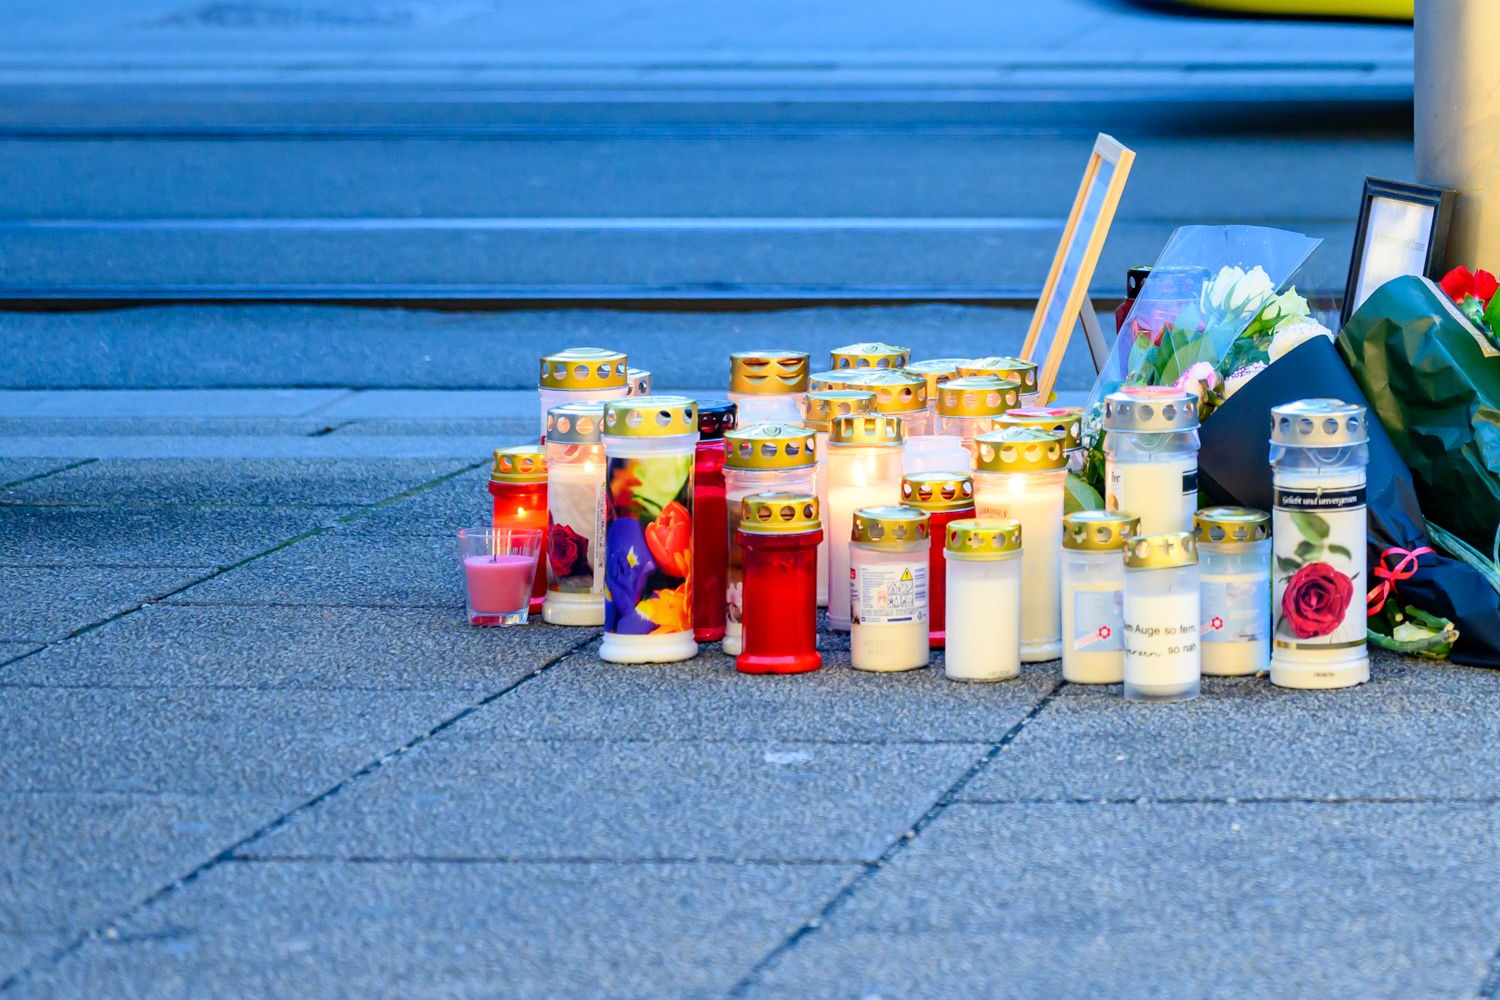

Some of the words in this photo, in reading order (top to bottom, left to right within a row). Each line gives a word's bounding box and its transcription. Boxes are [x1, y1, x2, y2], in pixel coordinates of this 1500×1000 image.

[1303, 496, 1318, 506] und
[1135, 624, 1160, 637] Auge
[1164, 627, 1176, 636] so
[1168, 646, 1180, 655] so
